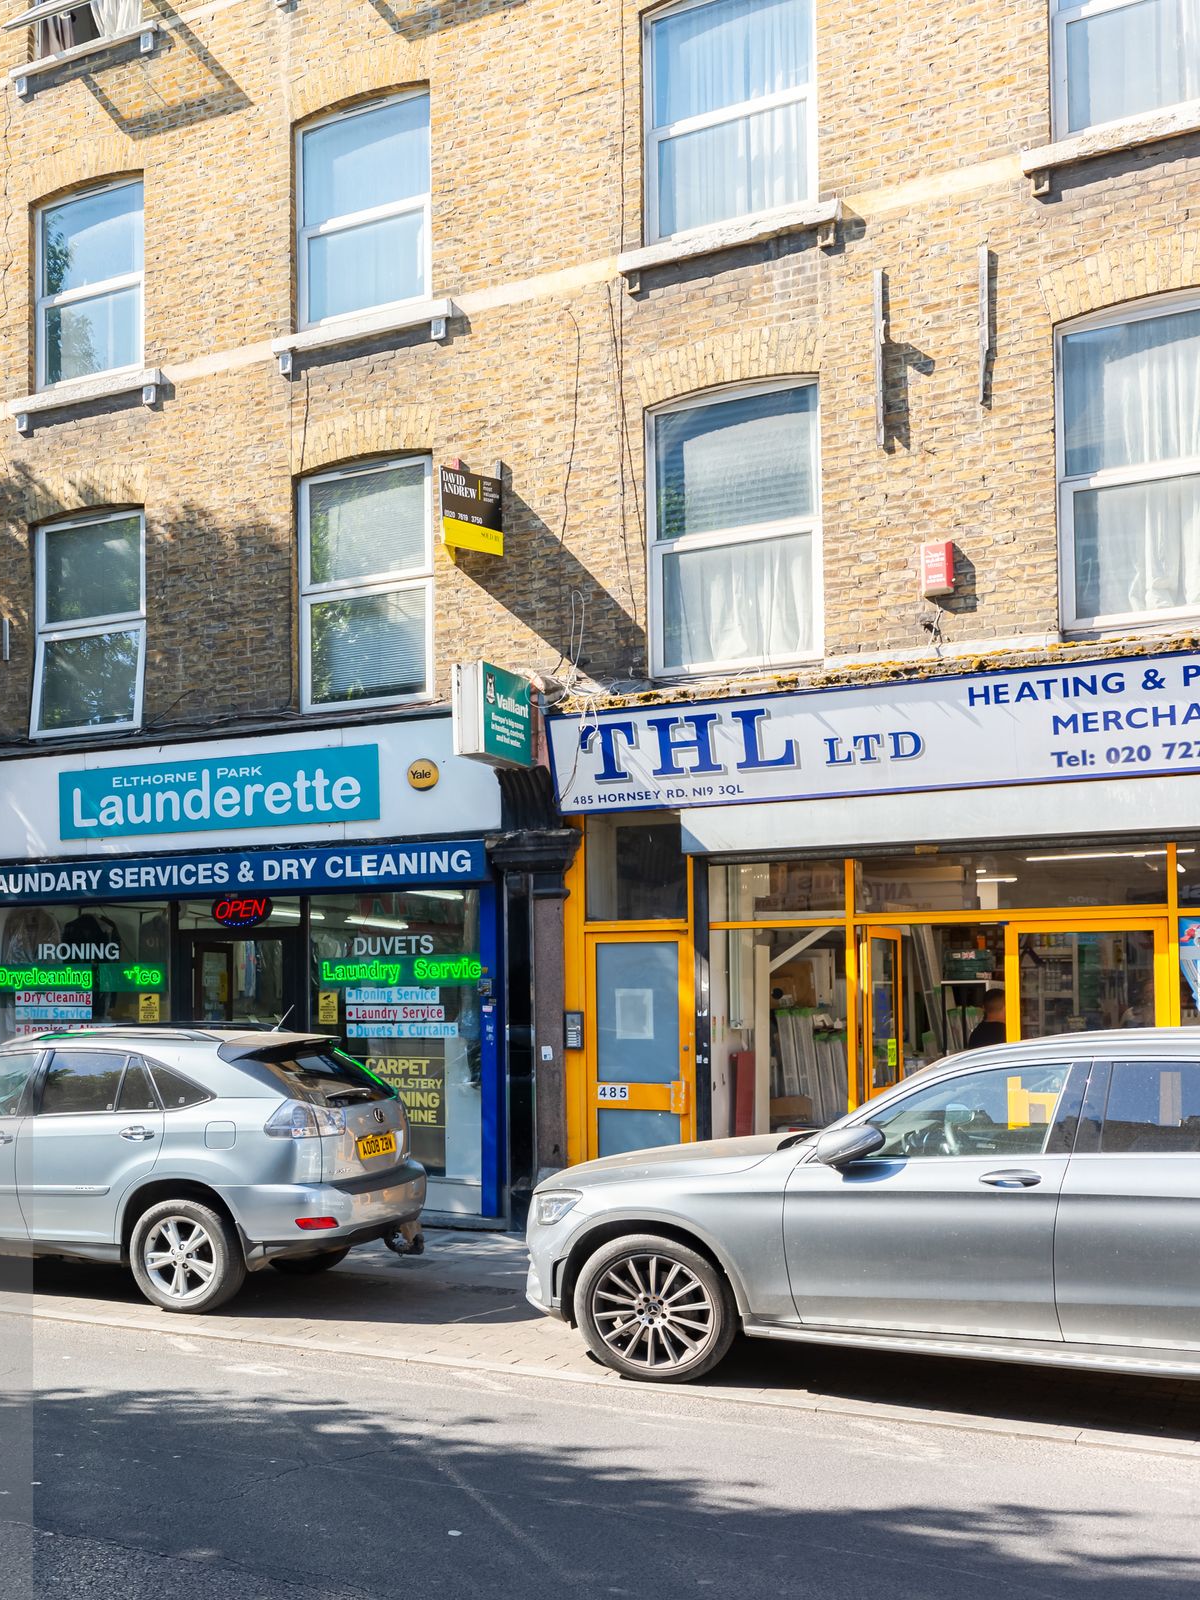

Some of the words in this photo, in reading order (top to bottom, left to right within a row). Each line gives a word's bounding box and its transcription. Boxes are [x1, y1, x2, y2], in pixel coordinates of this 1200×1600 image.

[442, 471, 465, 486] DAVID
[443, 482, 477, 499] ANDREW
[968, 673, 1125, 706] HEATING
[1141, 669, 1166, 691] &
[496, 693, 529, 718] Vaillant
[579, 707, 801, 785] THL
[824, 730, 925, 767] LTD
[1050, 750, 1095, 768] Tel:
[1105, 744, 1151, 765] 020
[410, 769, 431, 780] Yale
[73, 768, 361, 828] Launderette
[573, 794, 594, 806] 485
[598, 789, 660, 804] HORNSEY
[666, 787, 689, 799] RD.
[719, 783, 744, 796] 3QL
[109, 862, 229, 889] SERVICES
[237, 861, 255, 883] &
[263, 857, 317, 881] DRY
[325, 850, 472, 878] CLEANING
[215, 899, 266, 919] OPEN
[38, 942, 120, 961] IRONING
[354, 934, 433, 956] DUVETS
[322, 960, 400, 984] Laundry
[414, 958, 481, 979] Servic
[24, 992, 42, 1004] Dry
[45, 991, 92, 1005] Cleaning
[355, 988, 392, 1002] Ironing
[397, 988, 436, 1000] Service
[53, 1007, 91, 1018] Service
[355, 1007, 398, 1020] Laundry
[402, 1006, 443, 1019] Service
[356, 1024, 392, 1036] Duvets
[408, 1024, 456, 1036] Curtains
[365, 1058, 430, 1075] CARPET
[385, 1077, 443, 1089] HOLSTERY
[599, 1087, 627, 1099] 485
